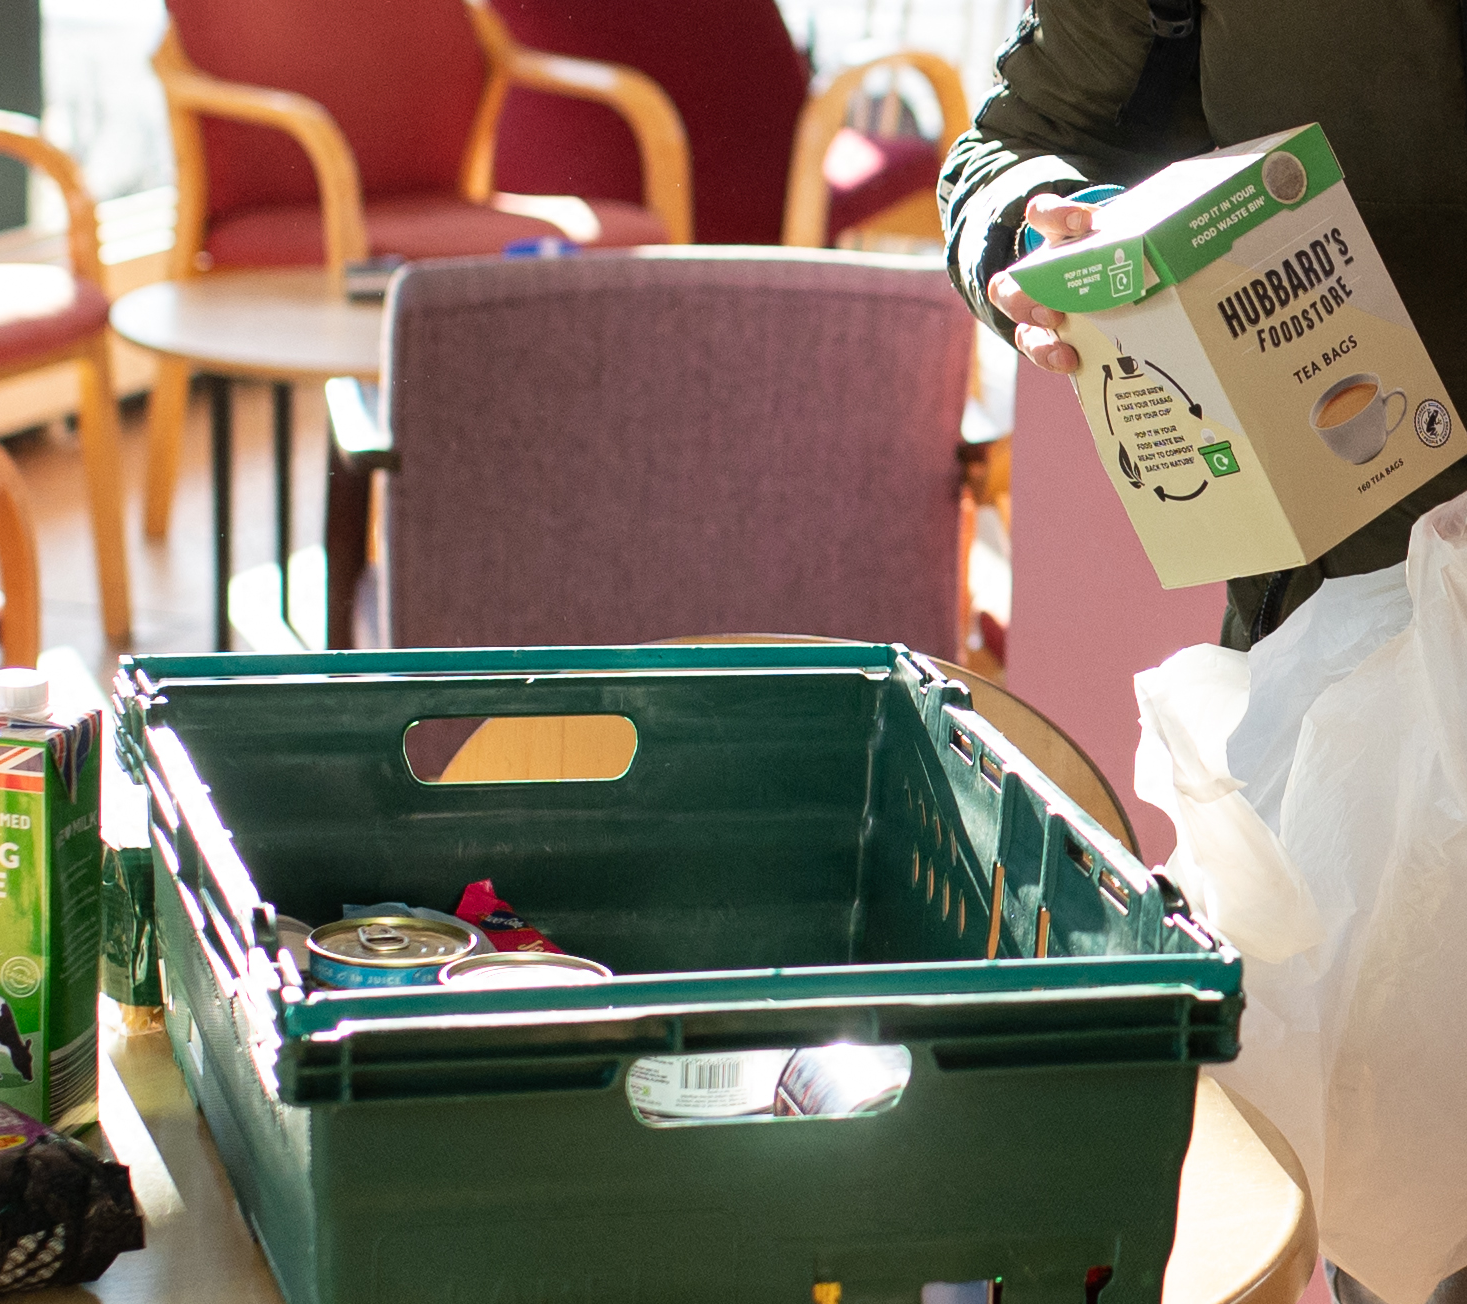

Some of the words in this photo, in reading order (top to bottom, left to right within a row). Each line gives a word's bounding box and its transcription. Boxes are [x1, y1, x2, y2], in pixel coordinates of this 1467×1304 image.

[1210, 206, 1221, 219] IT
[1221, 201, 1232, 213] IN
[1232, 184, 1257, 205] YOUR
[1191, 227, 1217, 248] FOOD
[1217, 209, 1249, 232] WASTE
[1217, 227, 1354, 340] HUBBARD'S
[1256, 275, 1353, 353] FOODSTORE
[1293, 361, 1322, 384] TEA
[1322, 334, 1358, 366] BAGS
[1357, 481, 1371, 494] 160
[1371, 471, 1386, 485] TEA
[1385, 458, 1404, 475] BAGS
